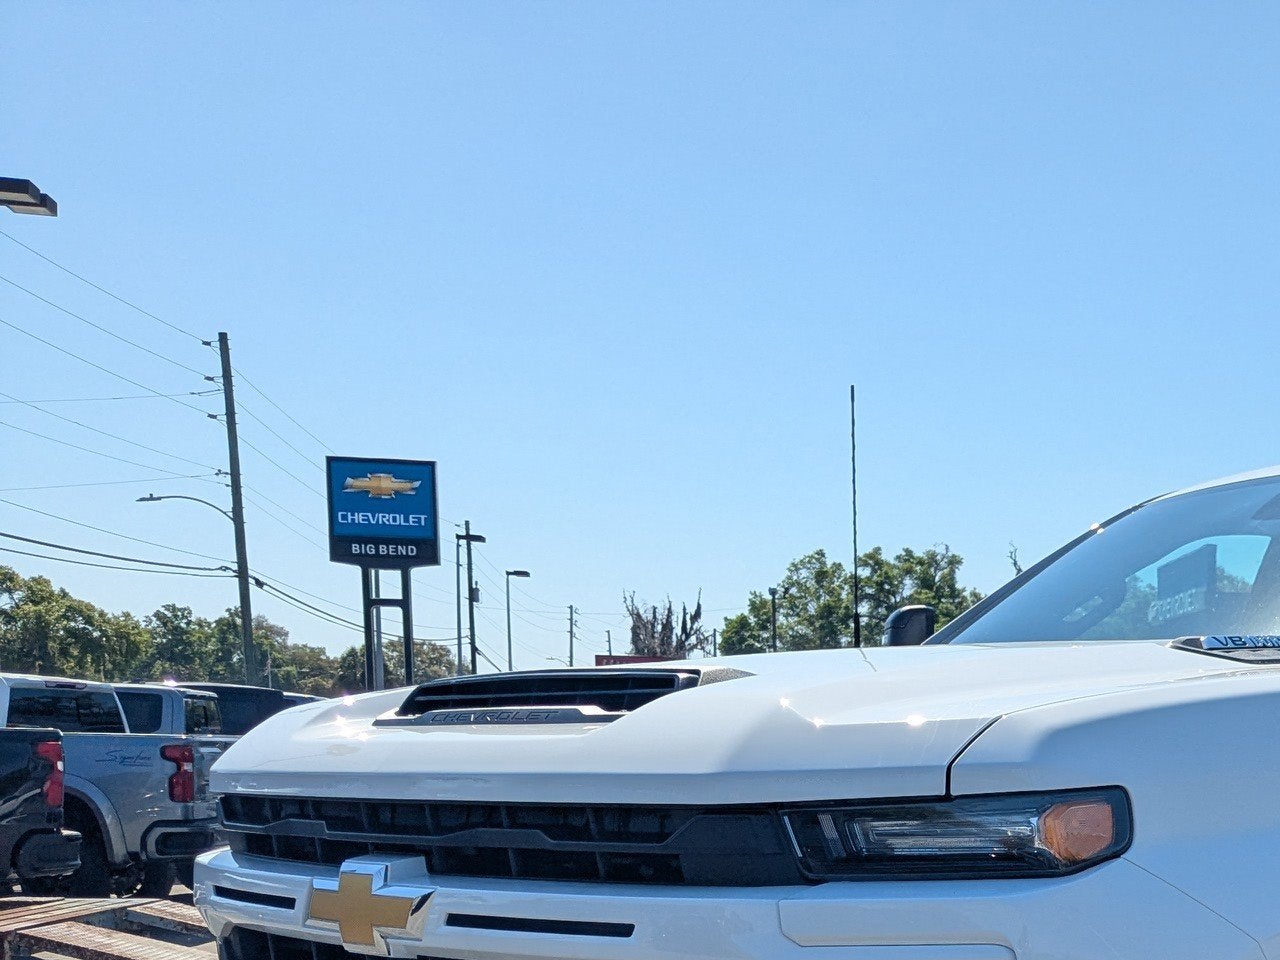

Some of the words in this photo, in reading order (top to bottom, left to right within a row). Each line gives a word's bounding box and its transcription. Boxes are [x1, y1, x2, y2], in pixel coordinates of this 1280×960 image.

[338, 512, 428, 526] CHEVROLET
[352, 544, 376, 555] BIG
[379, 545, 417, 556] BEND
[430, 710, 559, 723] CHEVROLET
